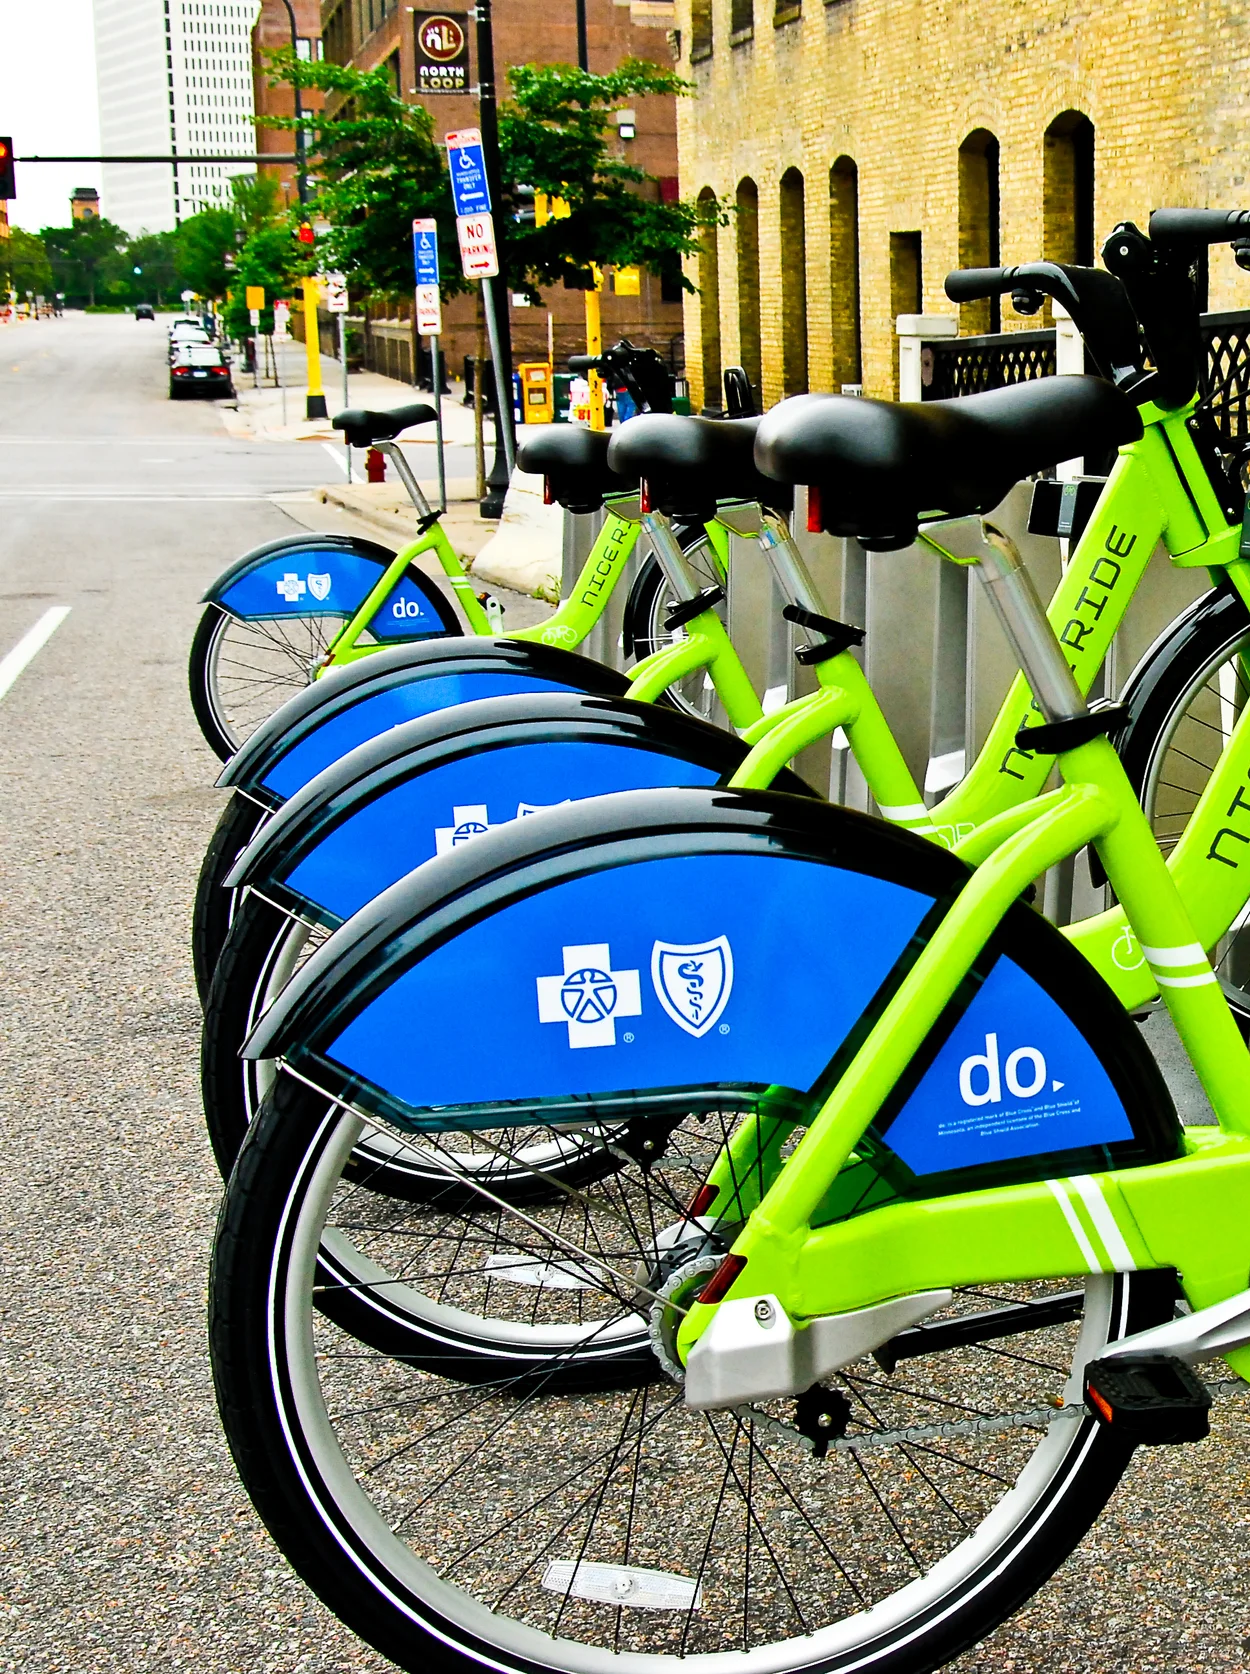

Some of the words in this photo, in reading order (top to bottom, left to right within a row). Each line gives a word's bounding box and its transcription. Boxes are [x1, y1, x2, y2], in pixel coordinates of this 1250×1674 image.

[420, 78, 464, 89] LOOP
[466, 223, 484, 239] NO
[1060, 525, 1137, 651] RIDE
